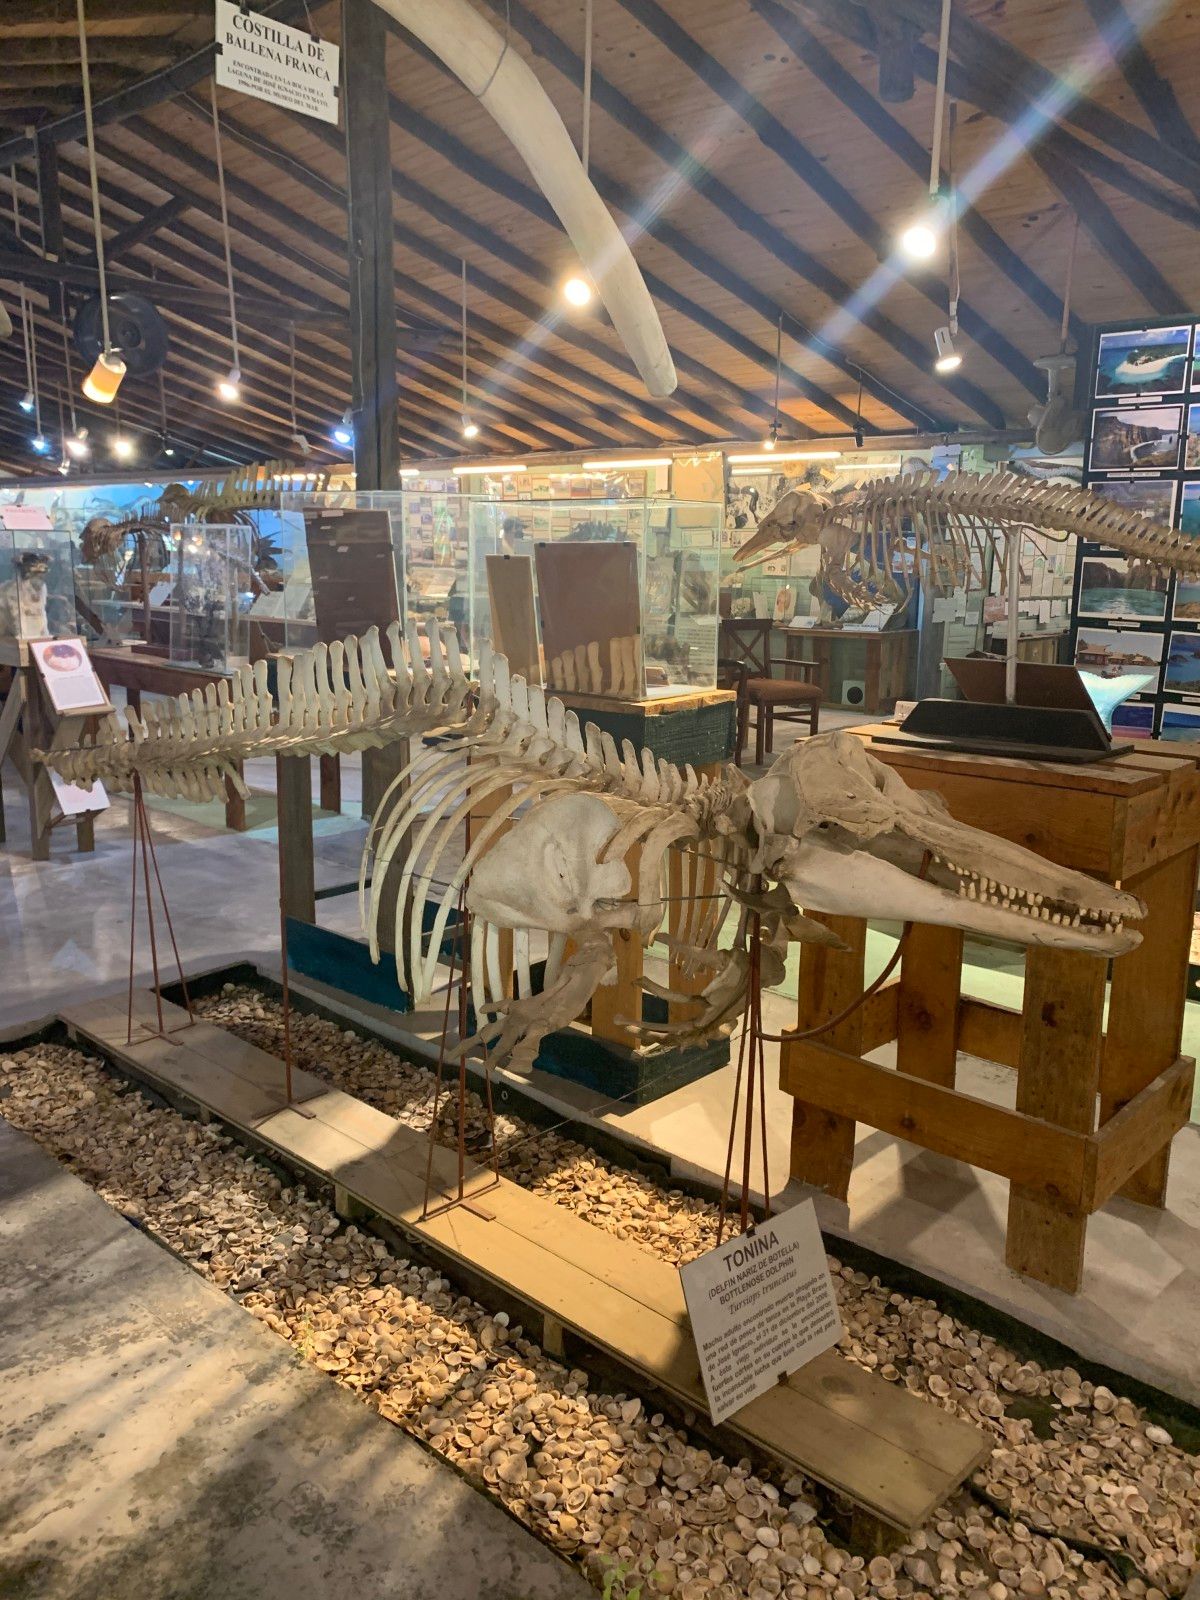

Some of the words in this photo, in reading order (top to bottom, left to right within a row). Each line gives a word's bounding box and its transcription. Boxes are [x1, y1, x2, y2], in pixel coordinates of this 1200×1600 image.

[226, 32, 282, 63] BALLENA
[285, 54, 330, 81] FRANCA
[232, 14, 303, 53] COSTILLA
[307, 43, 324, 61] DE
[722, 1231, 779, 1272] TONINA
[736, 1264, 757, 1282] NARIZ
[758, 1258, 767, 1270] DE
[768, 1241, 799, 1264] BOTELLA)
[719, 1272, 765, 1305] BOTTLENOSE
[765, 1255, 794, 1278] DOLPHIN
[728, 1290, 761, 1315] Tursiops
[702, 1336, 722, 1351] Macho
[710, 1374, 715, 1382] A
